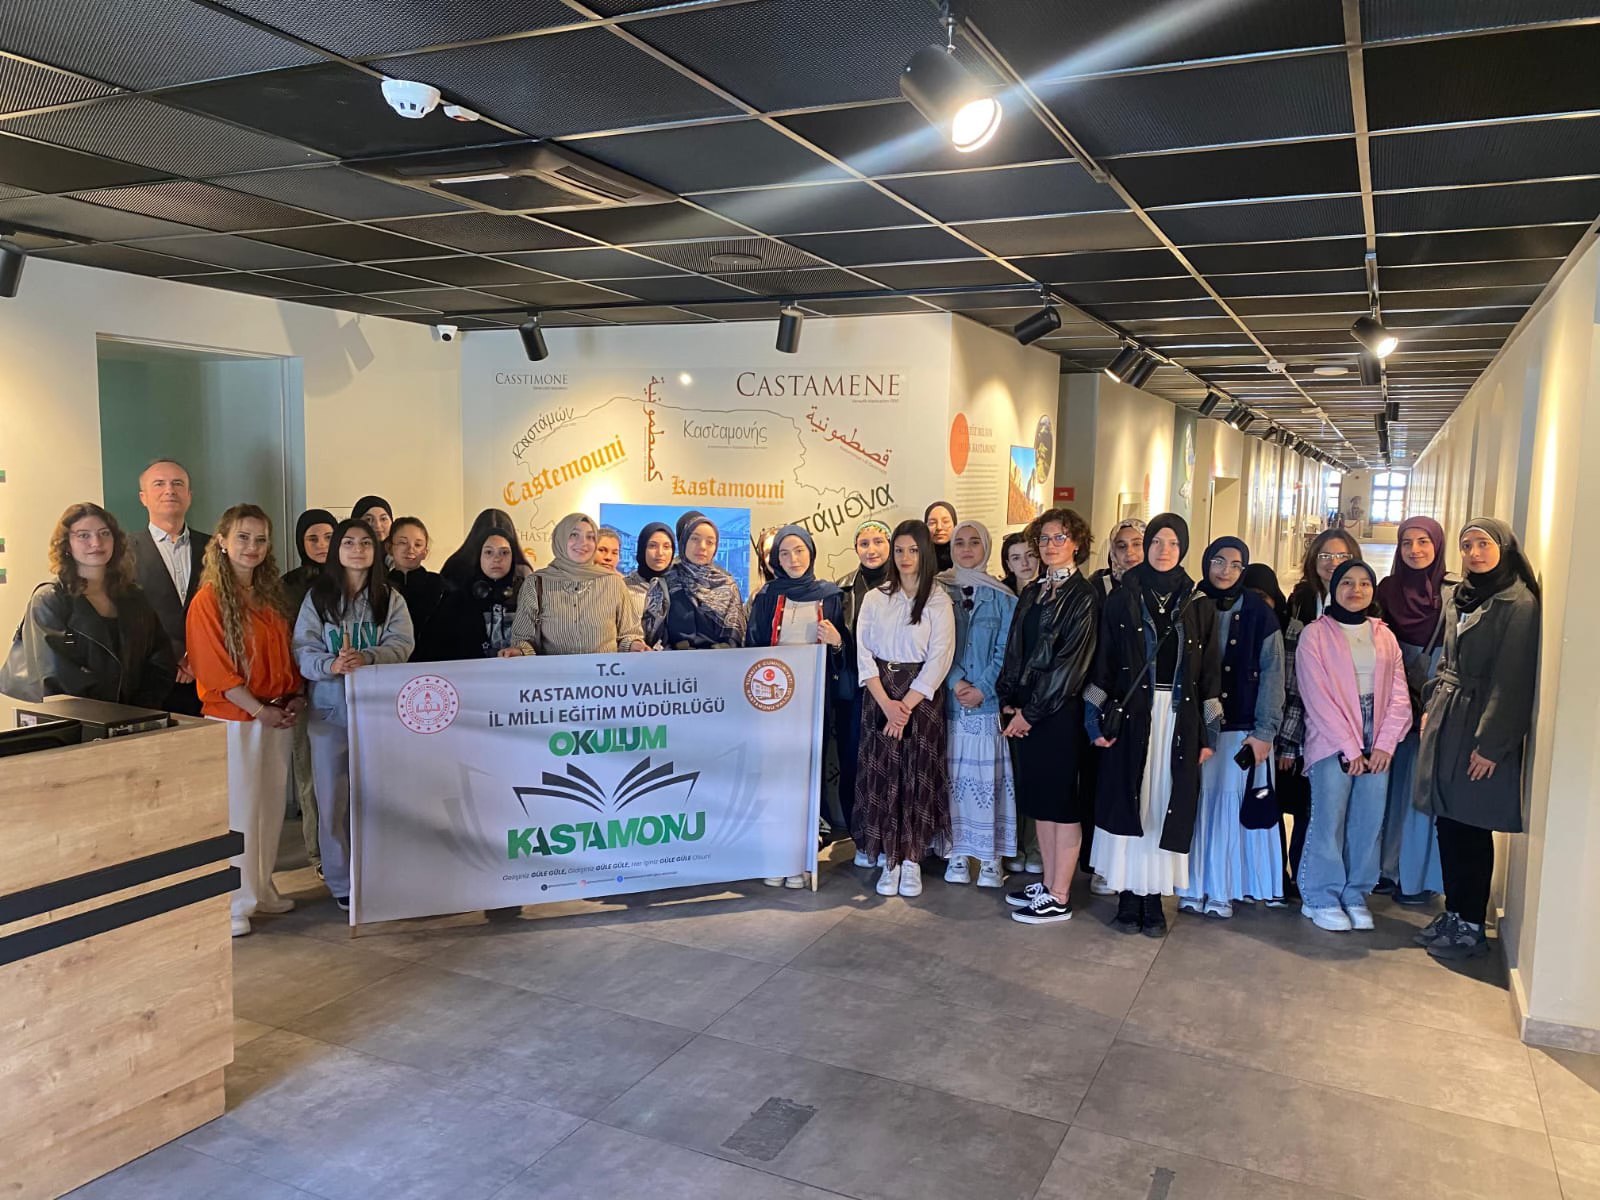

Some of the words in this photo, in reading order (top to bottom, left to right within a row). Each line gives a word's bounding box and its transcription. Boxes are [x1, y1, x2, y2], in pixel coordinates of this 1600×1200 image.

[736, 371, 900, 397] CASTAMENE
[503, 434, 626, 506] Castemouni
[671, 475, 784, 499] Kastamouni
[596, 663, 625, 677] T.C.
[519, 683, 628, 703] KASTAMONU
[632, 677, 698, 696] VALİLİĞİ
[489, 711, 504, 727] İL
[508, 707, 553, 726] MİLLİ
[558, 704, 616, 723] EĞİTİM
[621, 697, 725, 719] MÜDÜRLÜĞÜ
[548, 725, 667, 757] OKULUM
[508, 811, 706, 860] KASTAMONU
